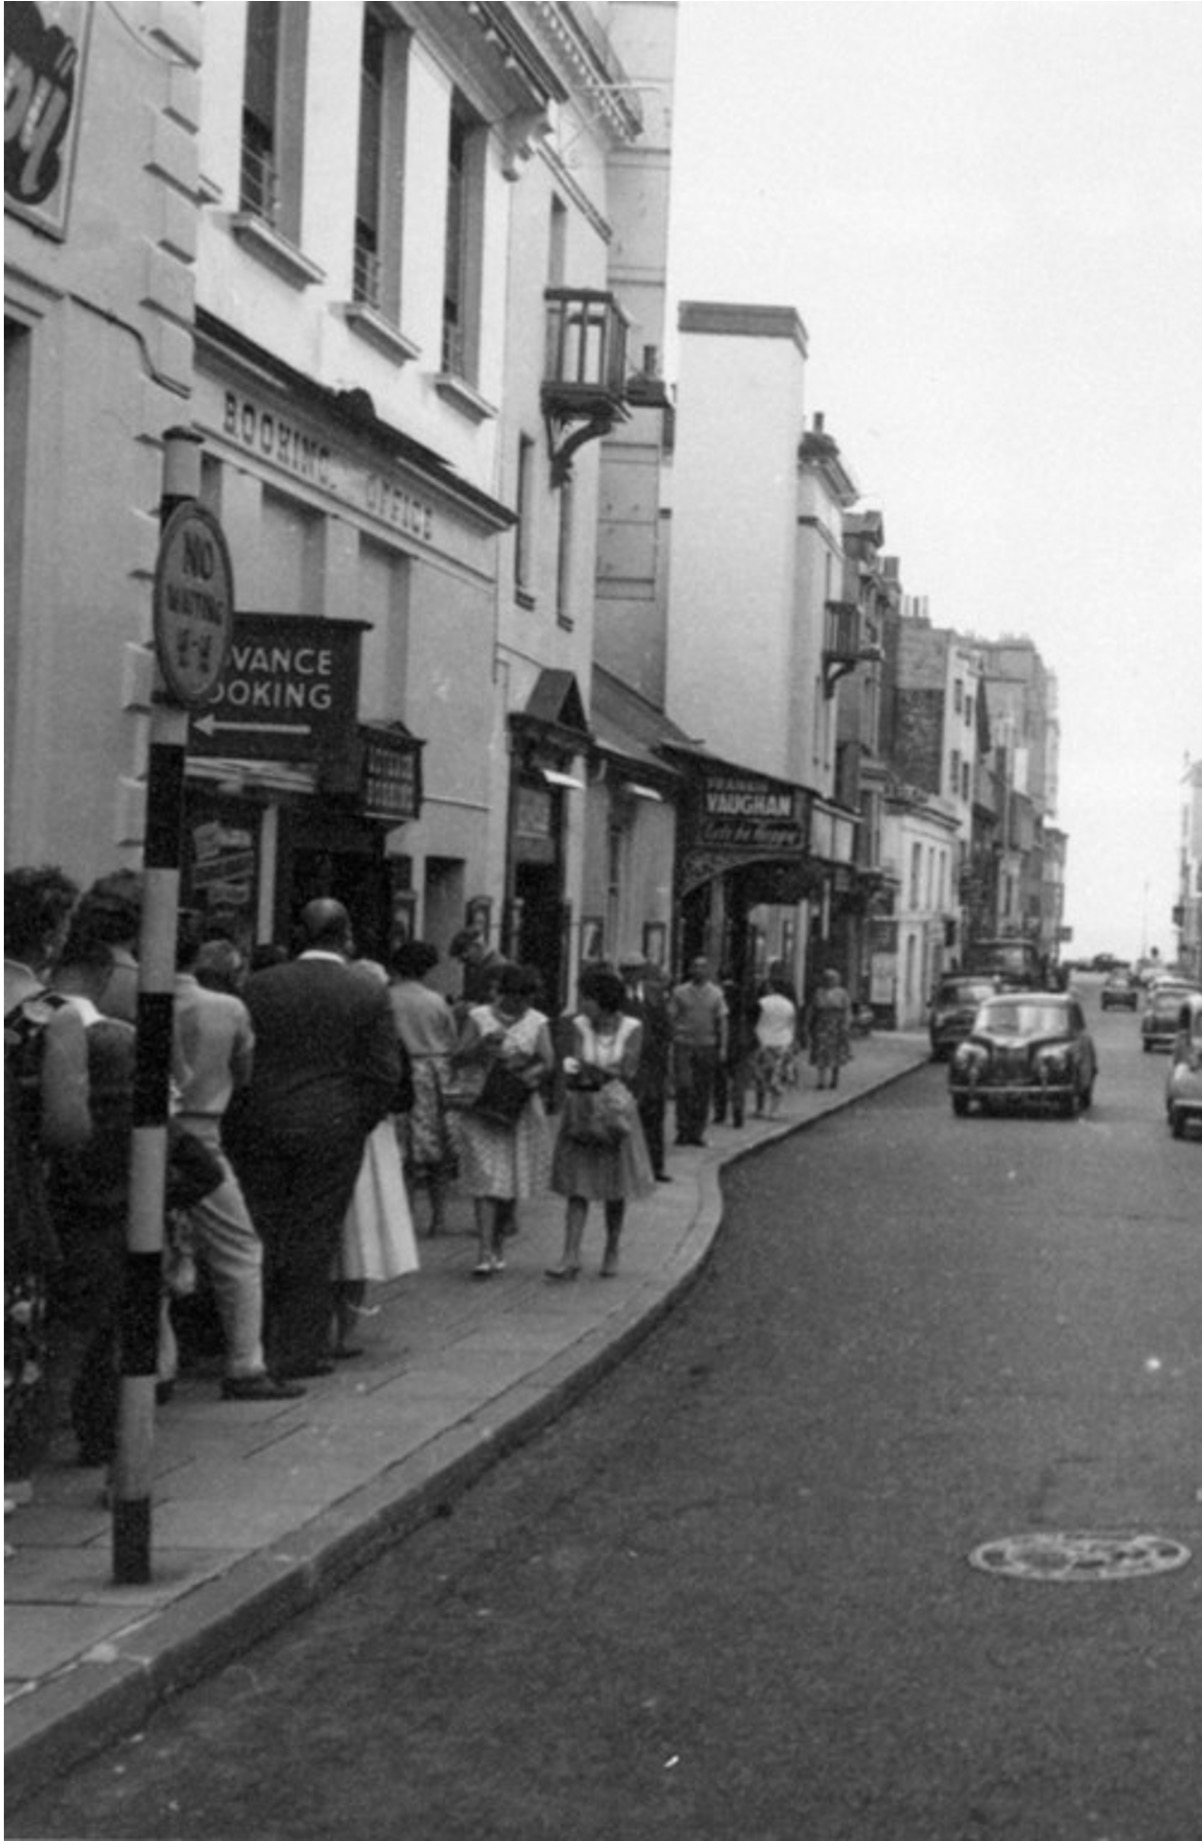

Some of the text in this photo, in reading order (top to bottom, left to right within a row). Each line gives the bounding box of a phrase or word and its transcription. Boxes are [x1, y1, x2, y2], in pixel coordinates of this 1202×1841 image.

[183, 530, 214, 580] NO
[226, 646, 332, 675] VANCE
[706, 792, 792, 817] VAUGHAN
